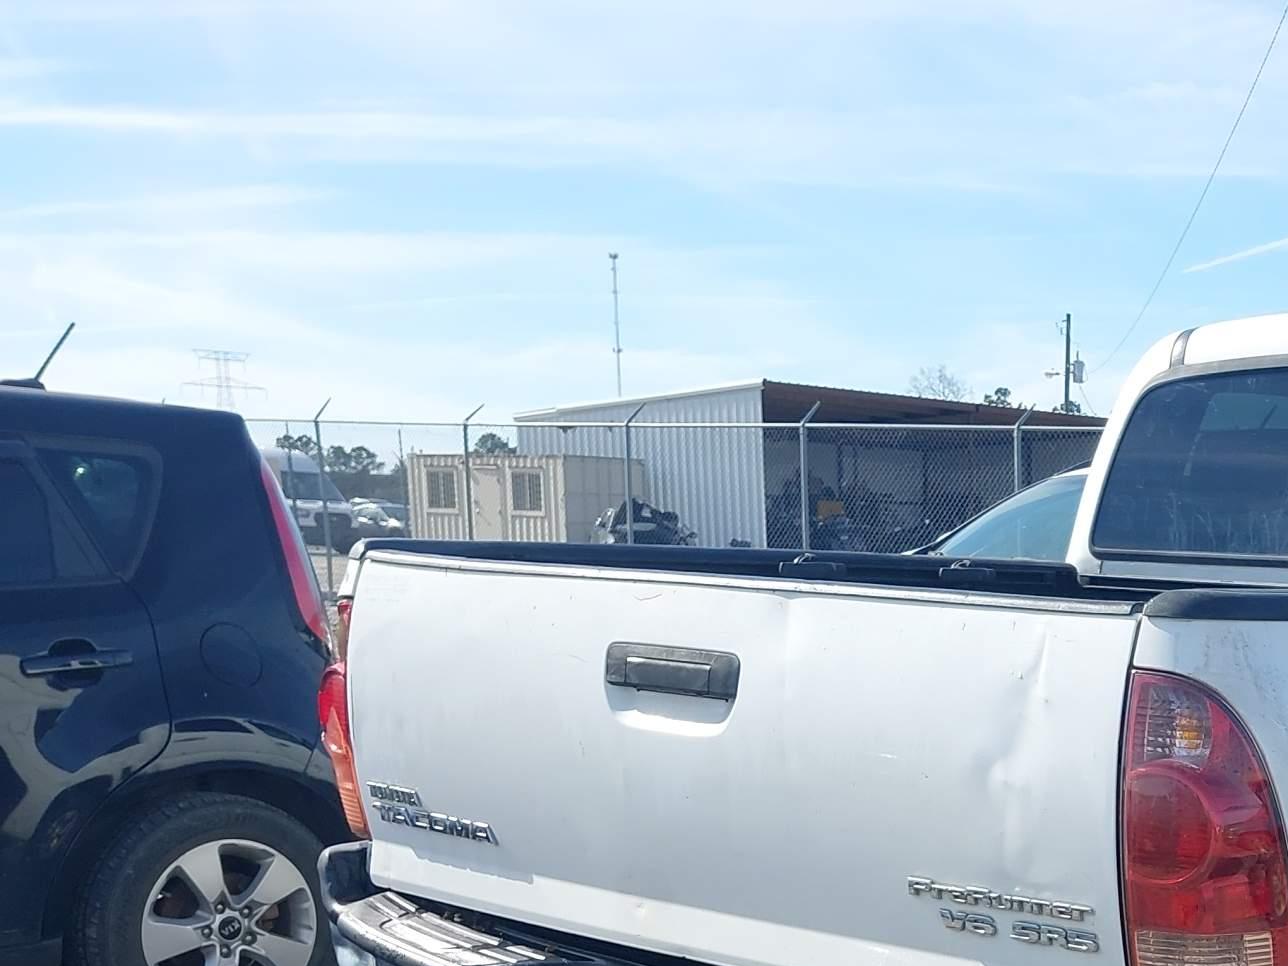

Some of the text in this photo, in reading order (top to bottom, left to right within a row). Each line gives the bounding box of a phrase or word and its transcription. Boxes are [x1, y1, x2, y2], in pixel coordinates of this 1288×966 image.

[371, 801, 500, 847] TACOMA
[939, 907, 1101, 953] V6 SR5
